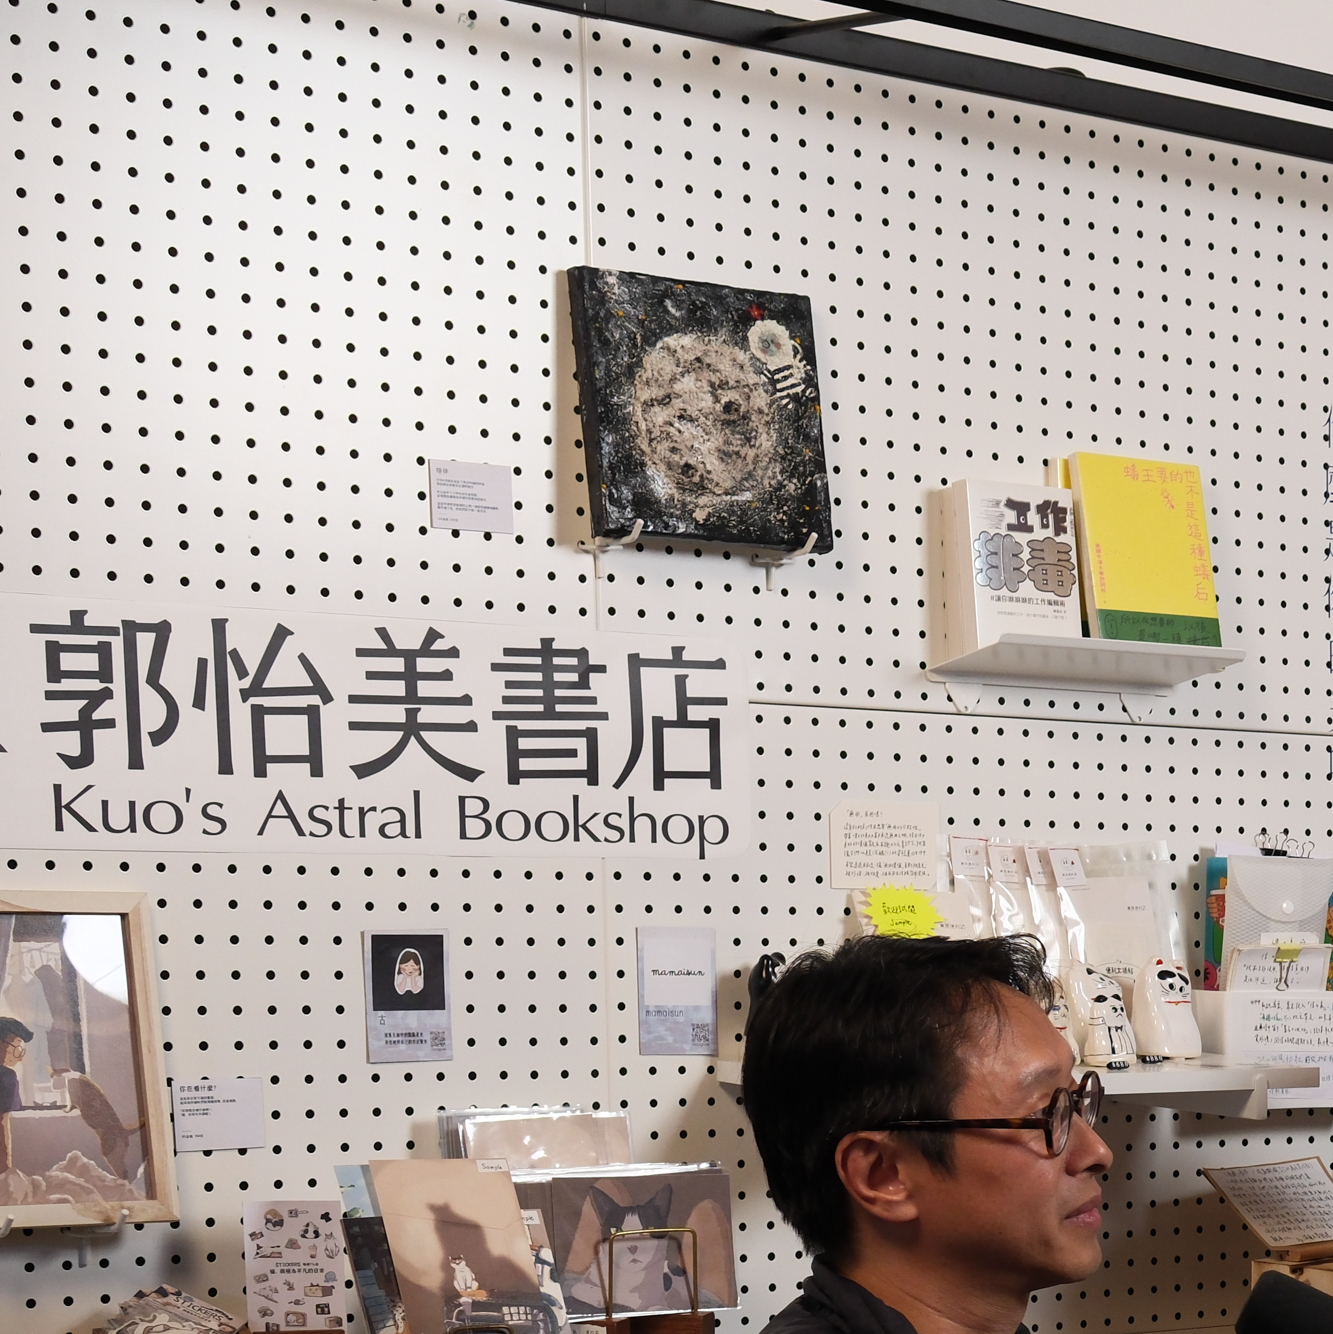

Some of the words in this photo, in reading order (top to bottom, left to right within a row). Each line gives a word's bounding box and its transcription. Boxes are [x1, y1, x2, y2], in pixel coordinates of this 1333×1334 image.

[1004, 497, 1068, 537] 工作
[974, 531, 1077, 597] 排毒
[29, 609, 728, 791] 郭怡美書店
[53, 784, 228, 836] Kuo's
[257, 789, 422, 839] Astral
[459, 794, 729, 859] Bookshop
[651, 967, 706, 977] mamaisun
[173, 1295, 226, 1322] STICKERS
